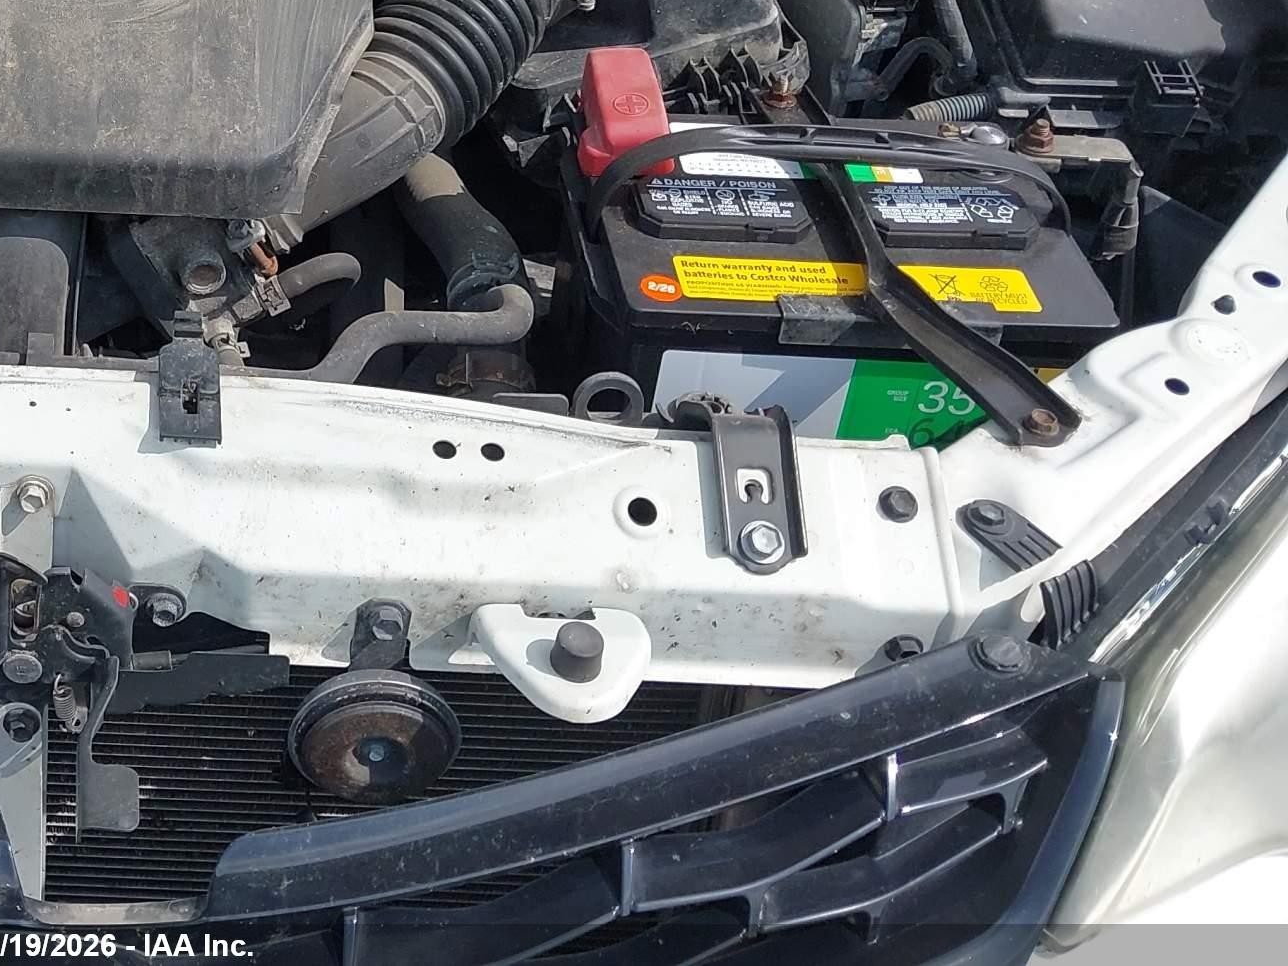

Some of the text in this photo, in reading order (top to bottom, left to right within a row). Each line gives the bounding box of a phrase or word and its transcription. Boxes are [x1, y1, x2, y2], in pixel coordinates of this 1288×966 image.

[664, 178, 716, 188] DANGER
[730, 180, 777, 189] POISON
[680, 260, 826, 274] Return warranty and used
[684, 269, 849, 285] batteries to Costco Wholesale
[917, 380, 976, 416] 35
